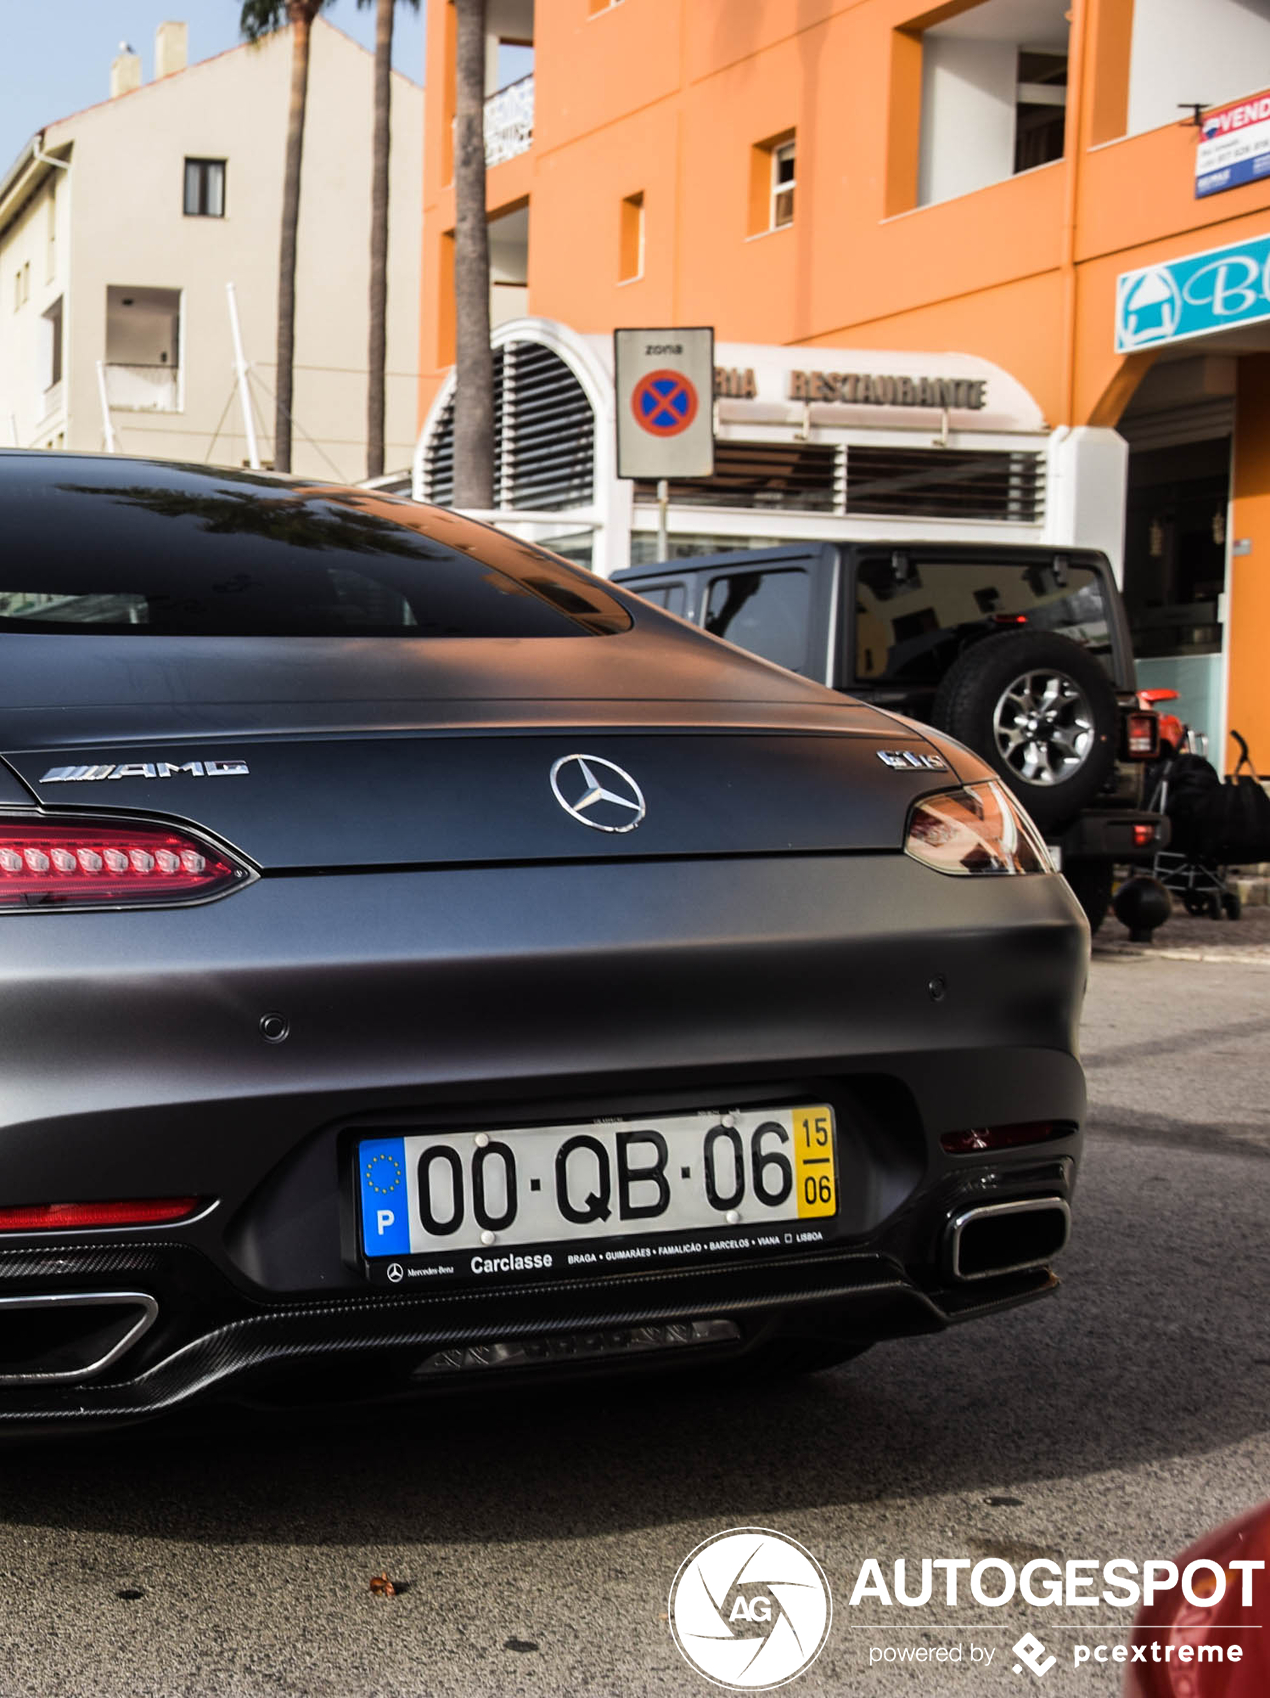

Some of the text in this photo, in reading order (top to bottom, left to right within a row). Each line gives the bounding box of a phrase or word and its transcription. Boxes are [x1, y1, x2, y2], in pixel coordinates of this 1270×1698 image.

[645, 344, 683, 356] zona
[790, 369, 988, 411] RESTAURANTE
[107, 760, 250, 780] AMG
[801, 1117, 829, 1148] 15
[803, 1174, 833, 1206] 06
[376, 1209, 396, 1236] P
[470, 1253, 553, 1274] Carclasse
[567, 1254, 597, 1265] BRAGA
[709, 1238, 750, 1251] BARCELOS
[757, 1236, 780, 1246] VIANA
[795, 1231, 823, 1243] LISBOA
